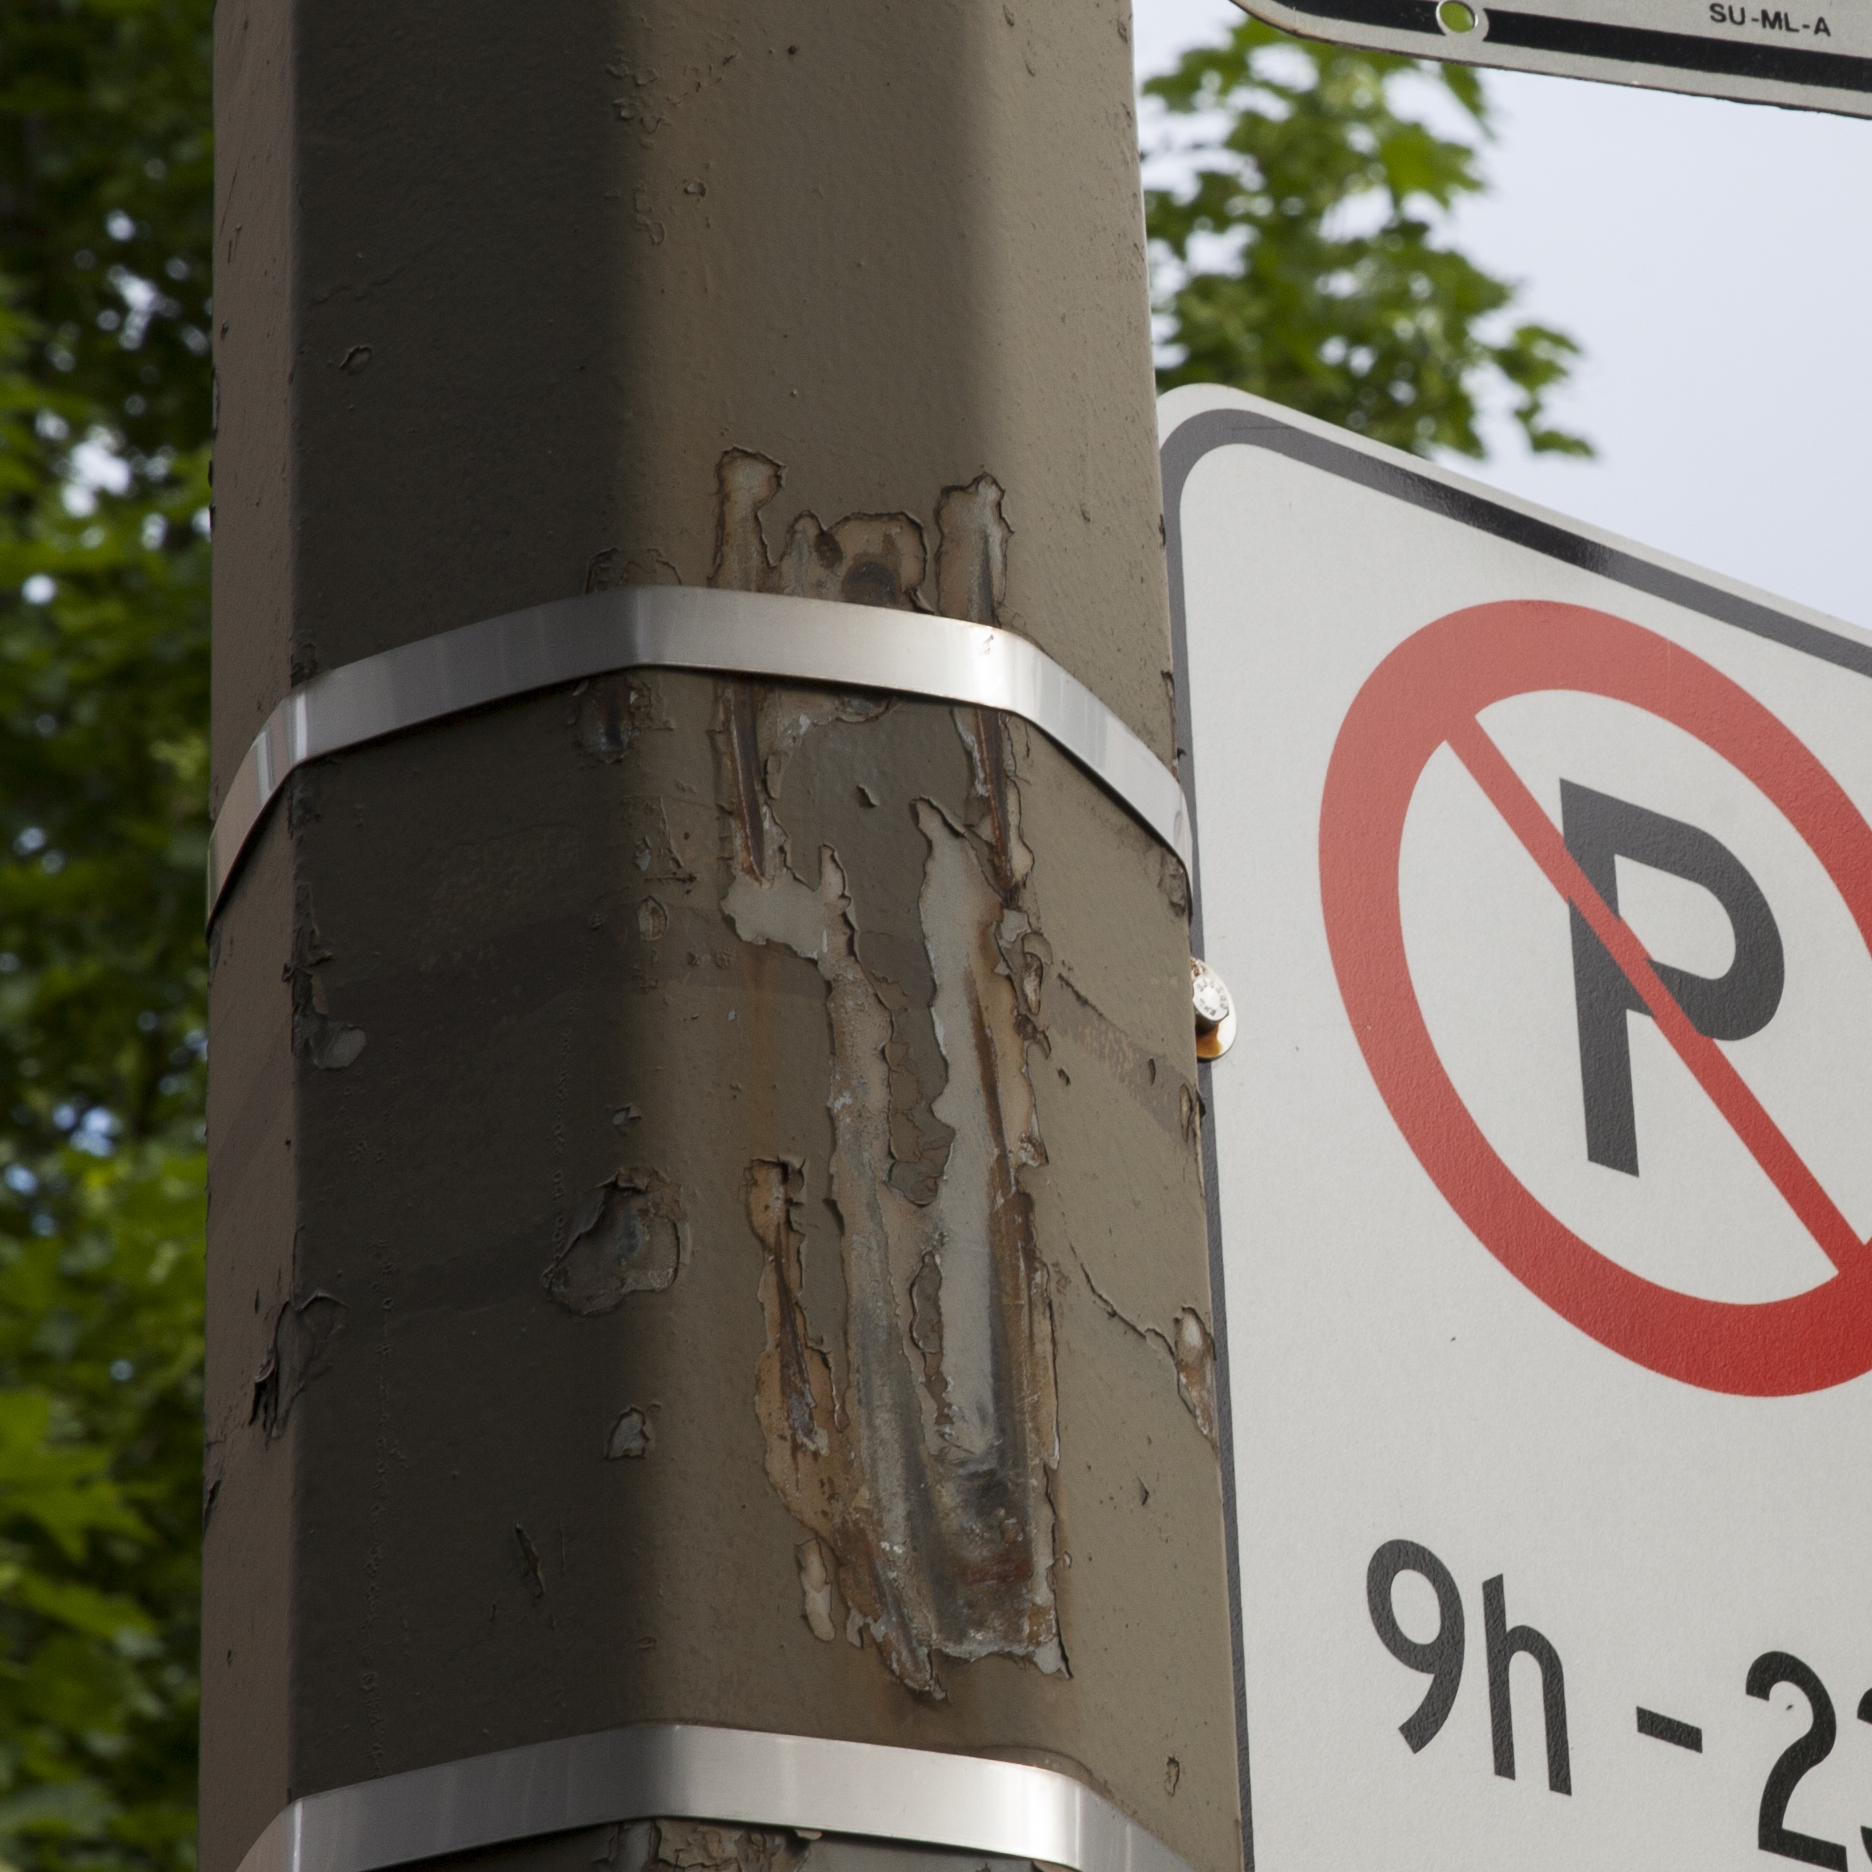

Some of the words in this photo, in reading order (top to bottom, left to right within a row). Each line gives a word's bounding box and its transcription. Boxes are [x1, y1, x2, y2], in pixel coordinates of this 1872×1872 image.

[1708, 1, 1833, 39] SU-ML-A
[1558, 776, 1785, 1179] P
[1366, 1539, 1572, 1797] 9h
